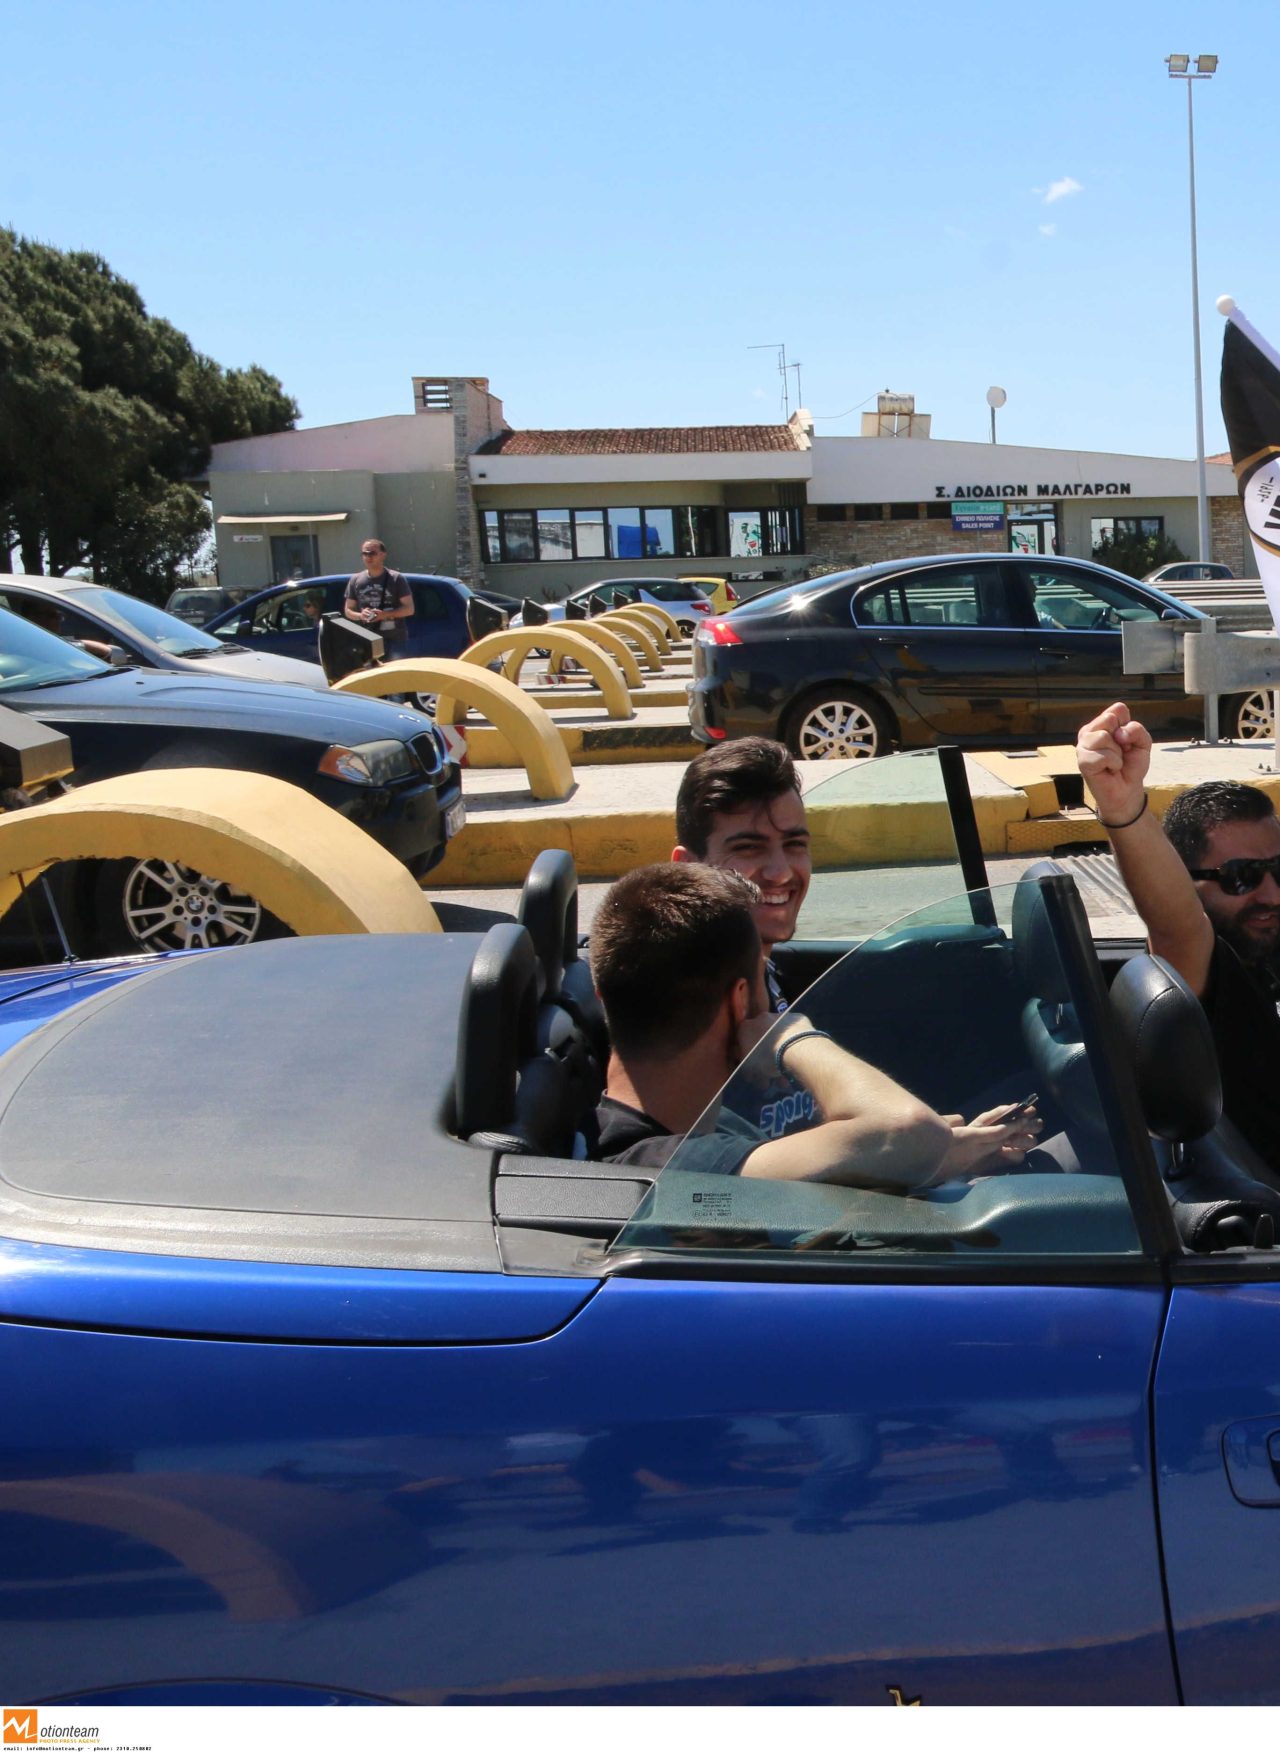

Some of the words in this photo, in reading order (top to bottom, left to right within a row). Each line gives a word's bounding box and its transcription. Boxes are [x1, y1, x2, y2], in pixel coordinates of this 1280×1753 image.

[935, 486, 950, 498] Σ.
[955, 484, 1028, 498] ΔΙΟΔΙΩΝ
[1037, 482, 1131, 496] ΜΑΛΓΑΡΩΝ
